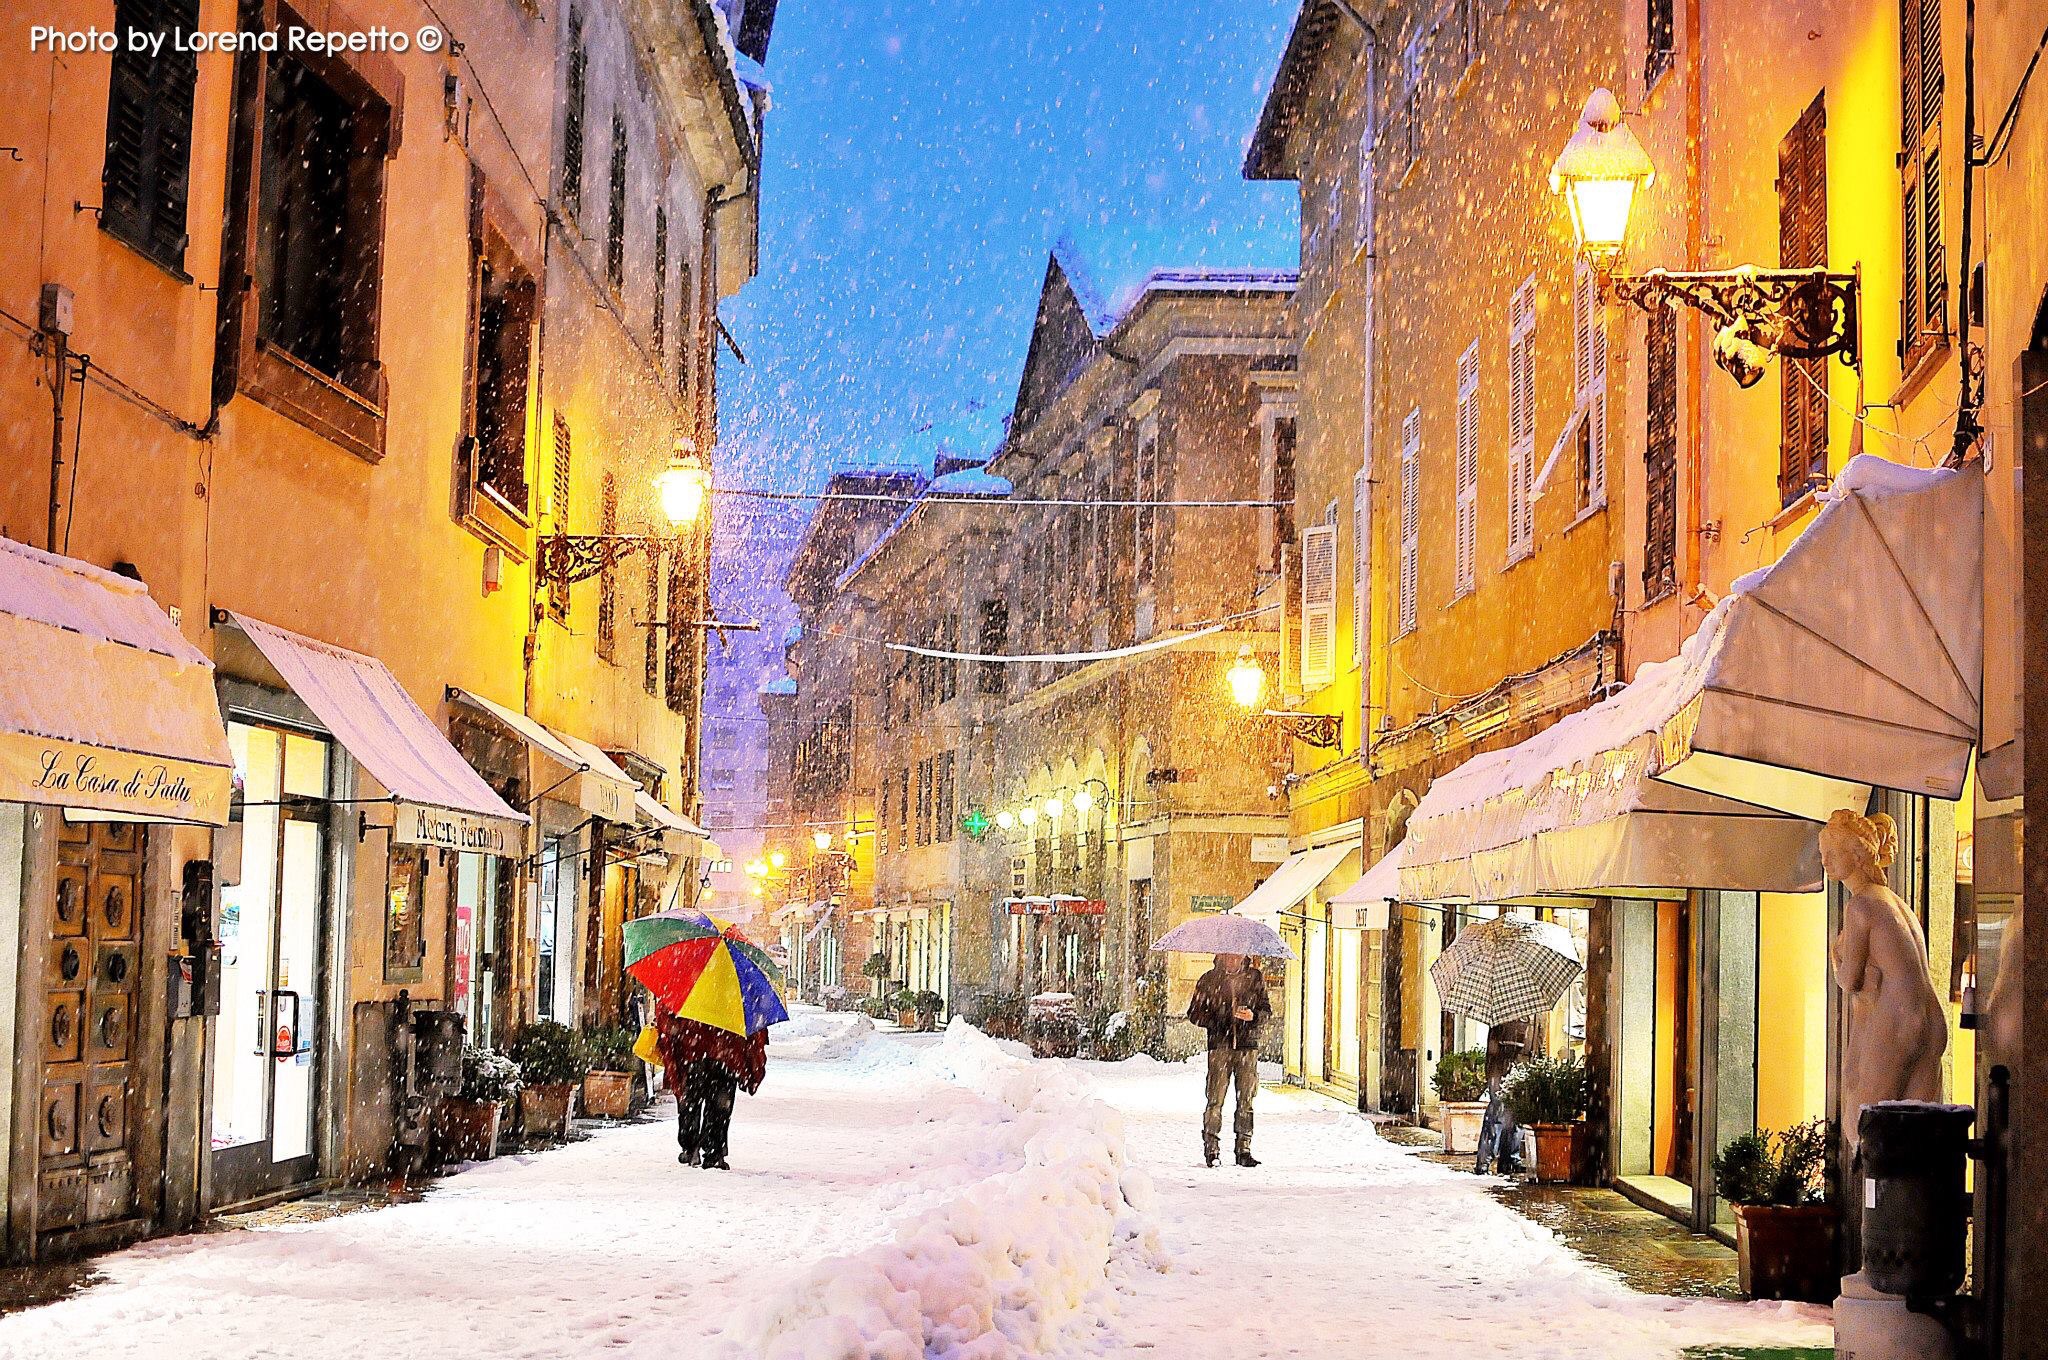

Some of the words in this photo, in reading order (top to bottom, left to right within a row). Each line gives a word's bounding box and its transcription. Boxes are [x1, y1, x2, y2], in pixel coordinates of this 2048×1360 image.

[32, 750, 70, 789] La
[76, 754, 120, 793] Casa
[123, 768, 144, 798] di
